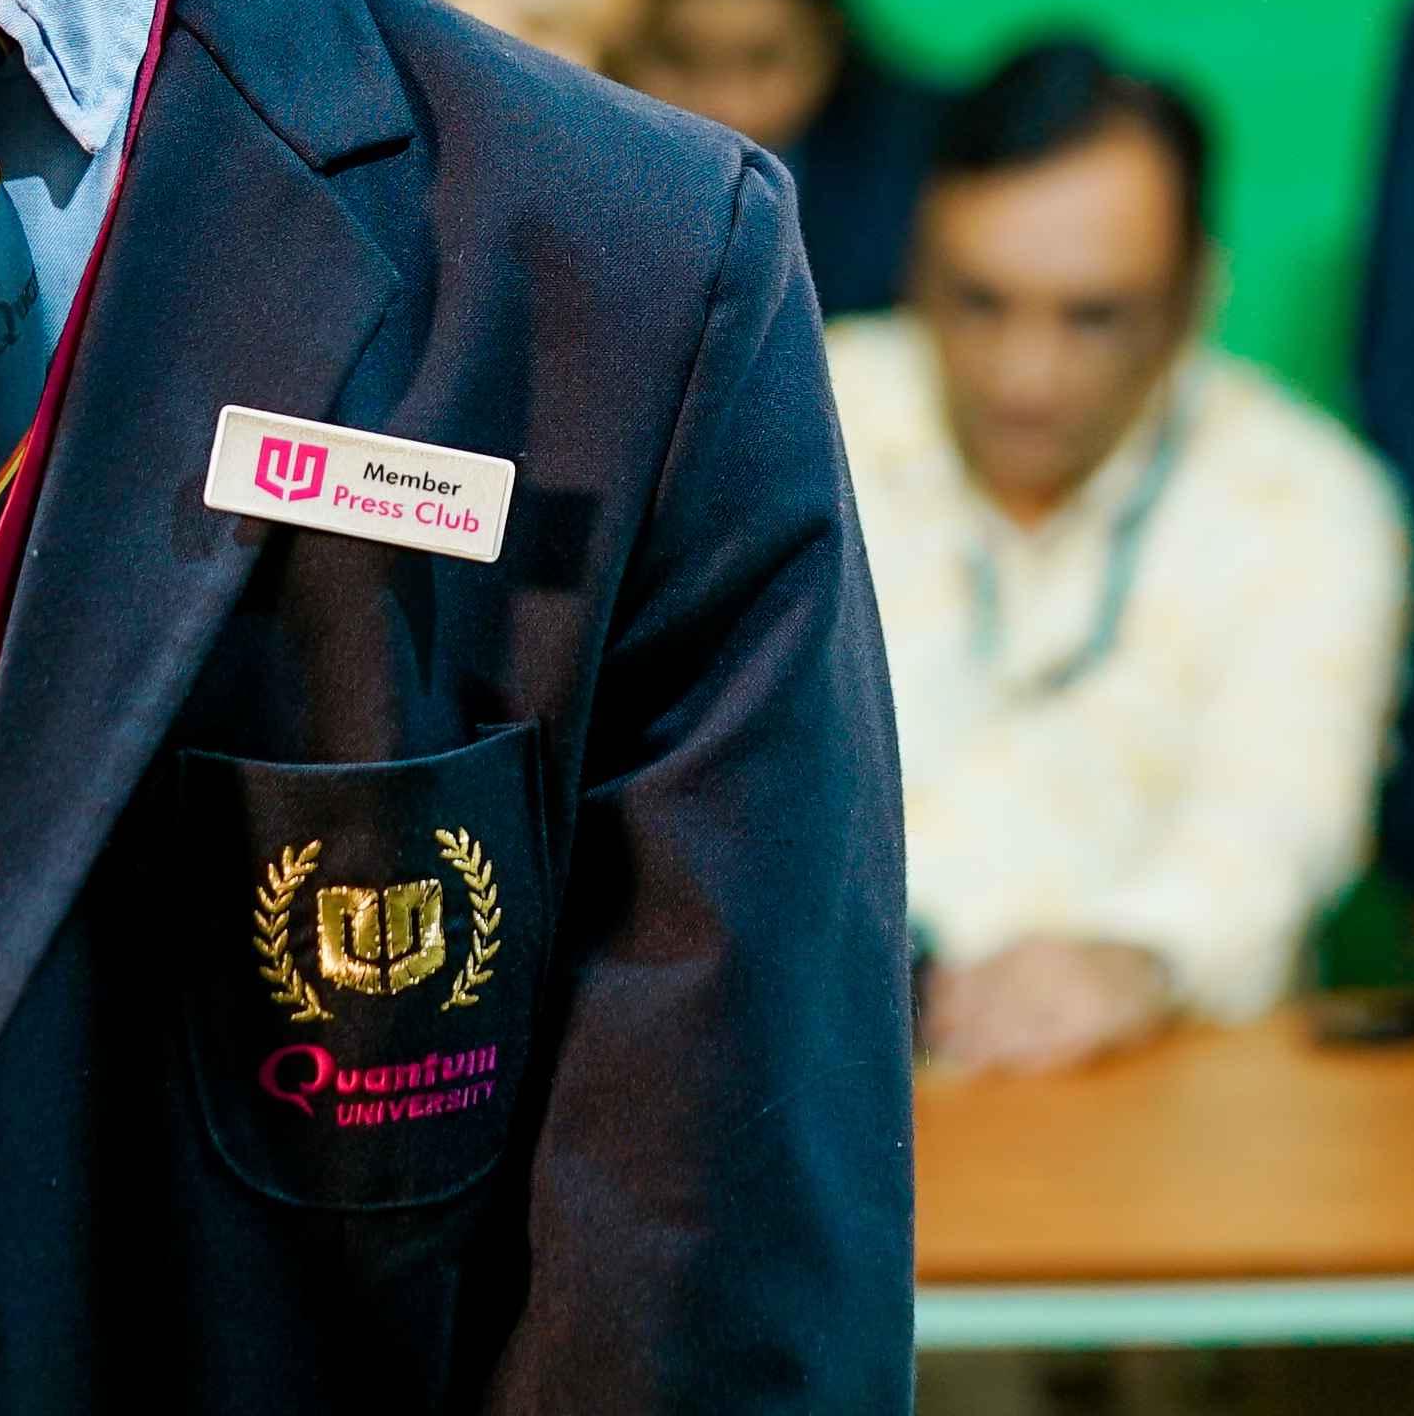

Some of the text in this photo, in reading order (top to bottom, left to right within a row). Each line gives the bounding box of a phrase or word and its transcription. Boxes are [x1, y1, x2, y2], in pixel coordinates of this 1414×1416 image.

[363, 462, 462, 496] Member
[333, 485, 480, 533] Press Club
[259, 1043, 497, 1118] Quantum
[337, 1080, 495, 1127] UNIVERSITY
